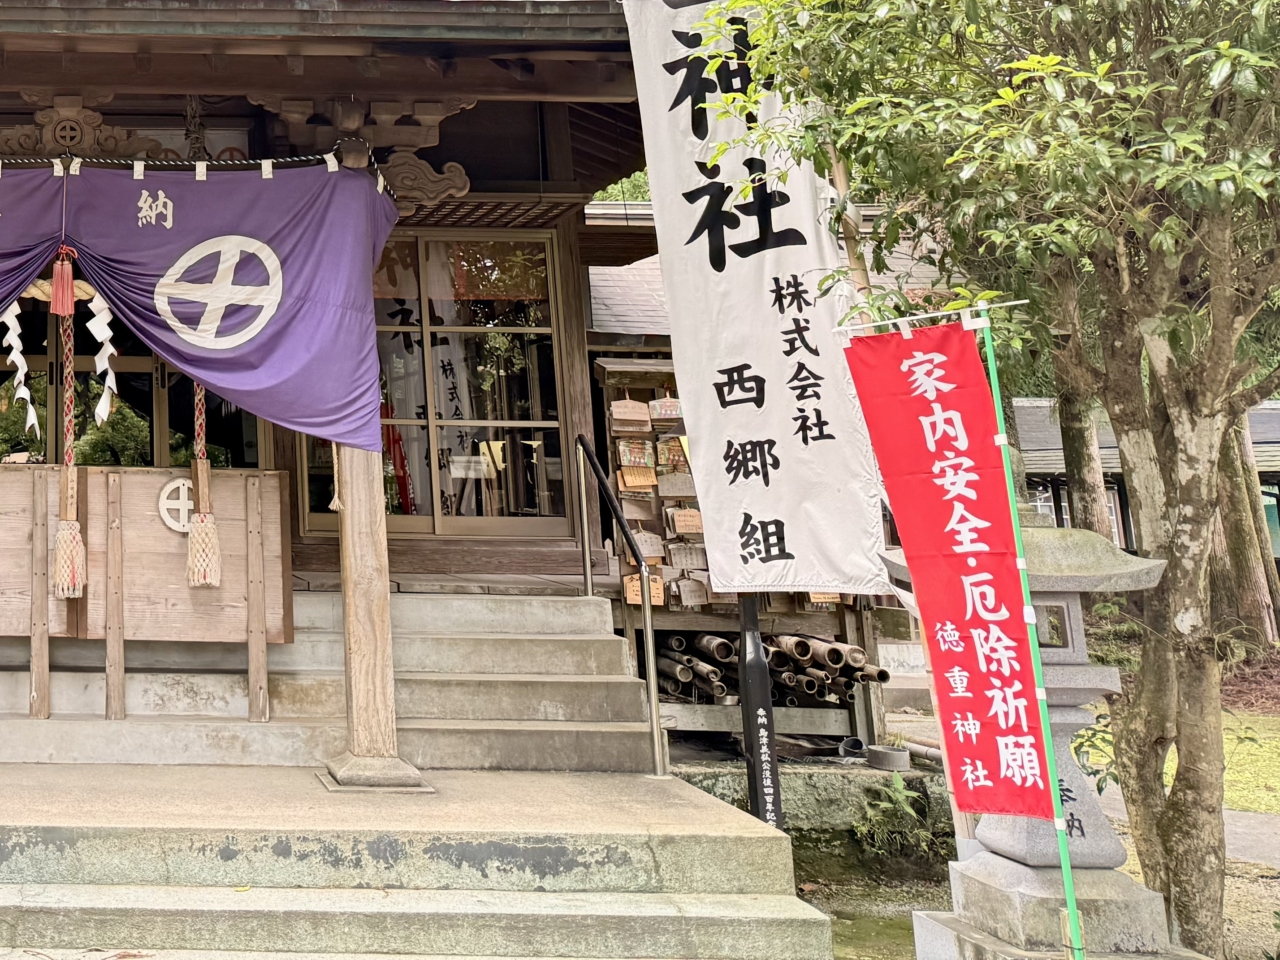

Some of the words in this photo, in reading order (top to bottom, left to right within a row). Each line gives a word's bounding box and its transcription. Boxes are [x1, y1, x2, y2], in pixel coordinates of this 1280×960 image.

[137, 189, 175, 230] 納
[770, 274, 836, 447] 株式会社
[713, 363, 796, 564] 西郷組
[900, 351, 1044, 789] 家内安全・厄除祈願
[933, 620, 993, 790] 徳重神社
